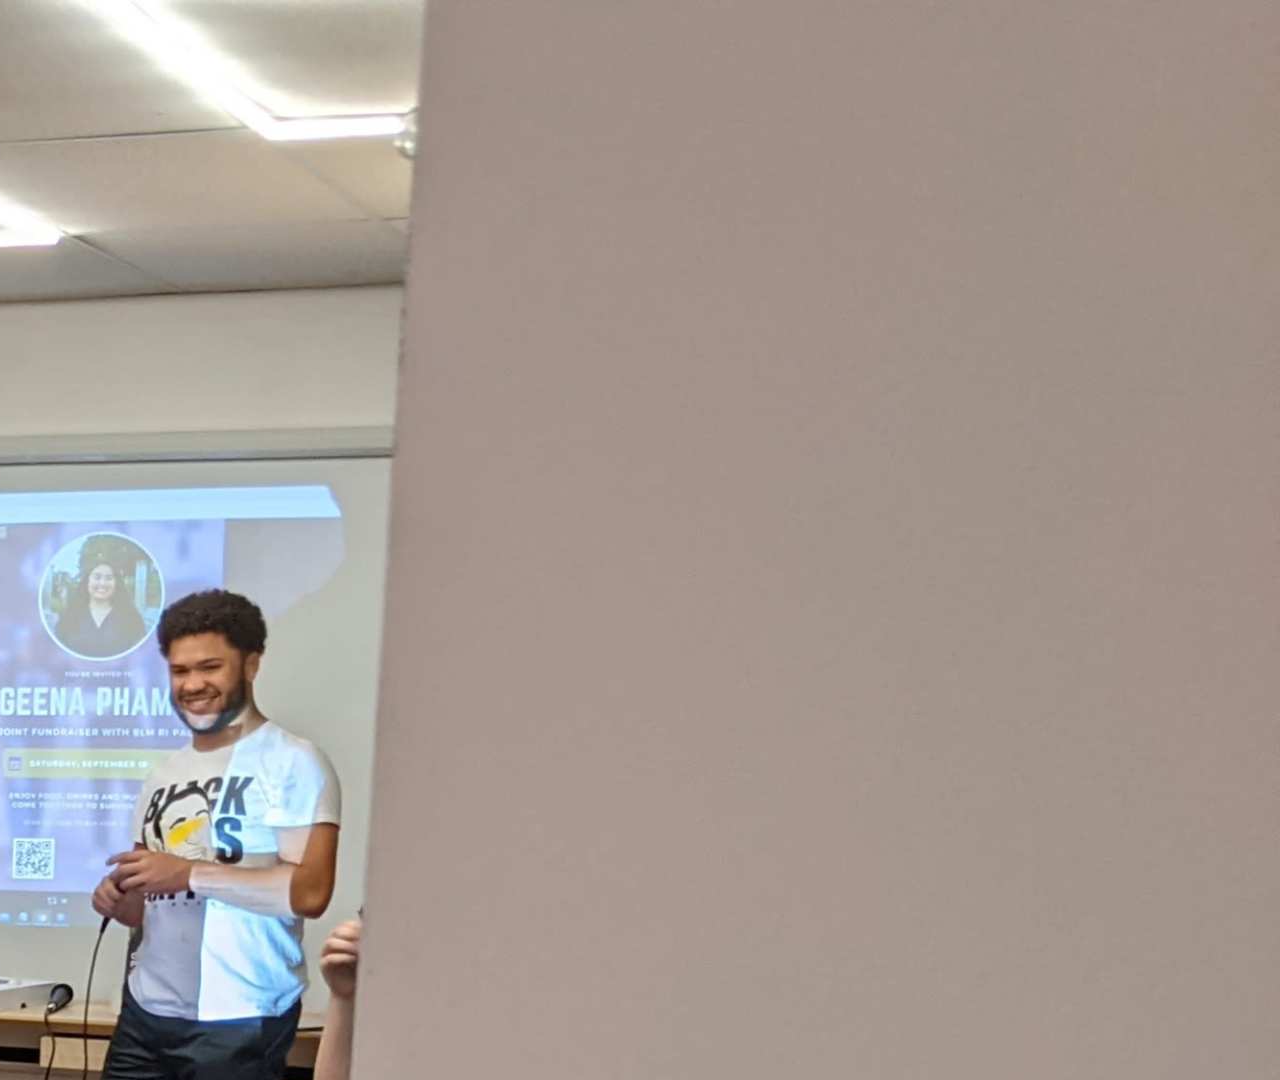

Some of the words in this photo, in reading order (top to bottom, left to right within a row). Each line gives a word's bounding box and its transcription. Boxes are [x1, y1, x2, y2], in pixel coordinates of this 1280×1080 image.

[0, 686, 86, 717] GEENA
[96, 686, 173, 717] PHAM
[32, 727, 98, 738] FUNDRAISER
[101, 727, 130, 738] WITH
[82, 760, 135, 769] SEPTEMBER
